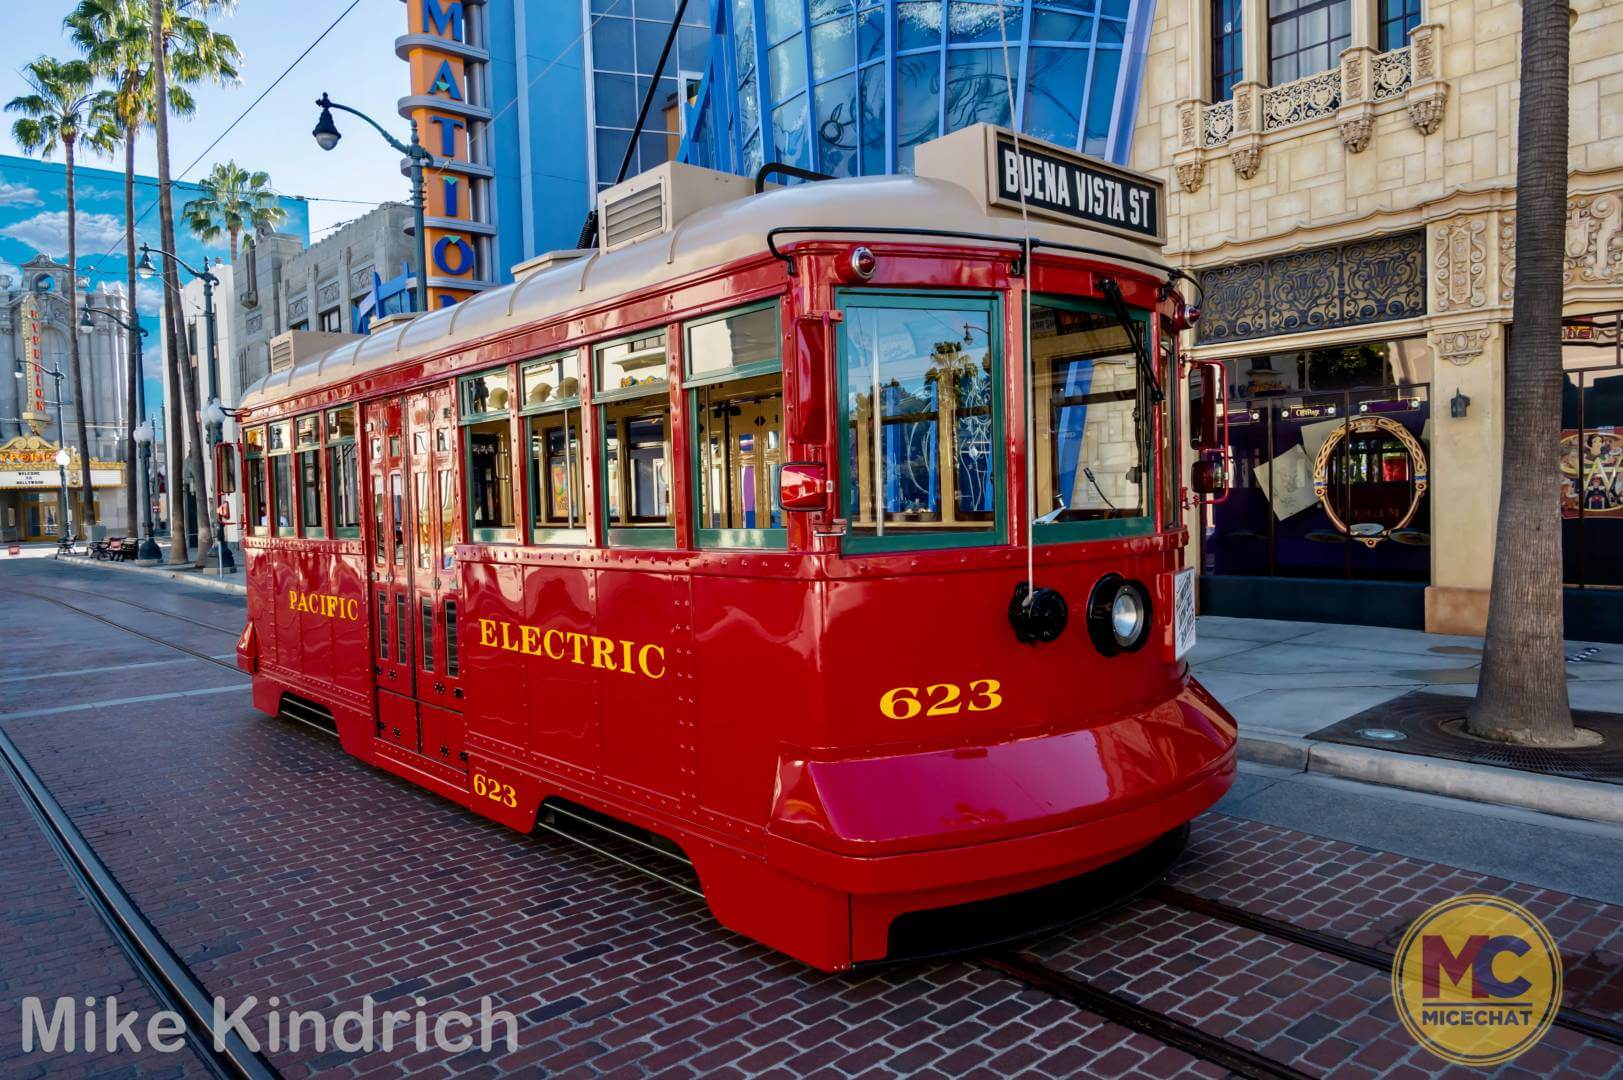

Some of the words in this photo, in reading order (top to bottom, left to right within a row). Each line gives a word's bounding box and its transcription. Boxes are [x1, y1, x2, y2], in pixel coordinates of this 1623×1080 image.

[1004, 149, 1071, 207] BUENA
[1075, 170, 1125, 221] VISTA
[1129, 188, 1150, 227] ST
[289, 590, 359, 621] PACIFIC
[478, 618, 666, 679] ELECTRIC
[879, 678, 1003, 720] 623
[473, 773, 518, 809] 623
